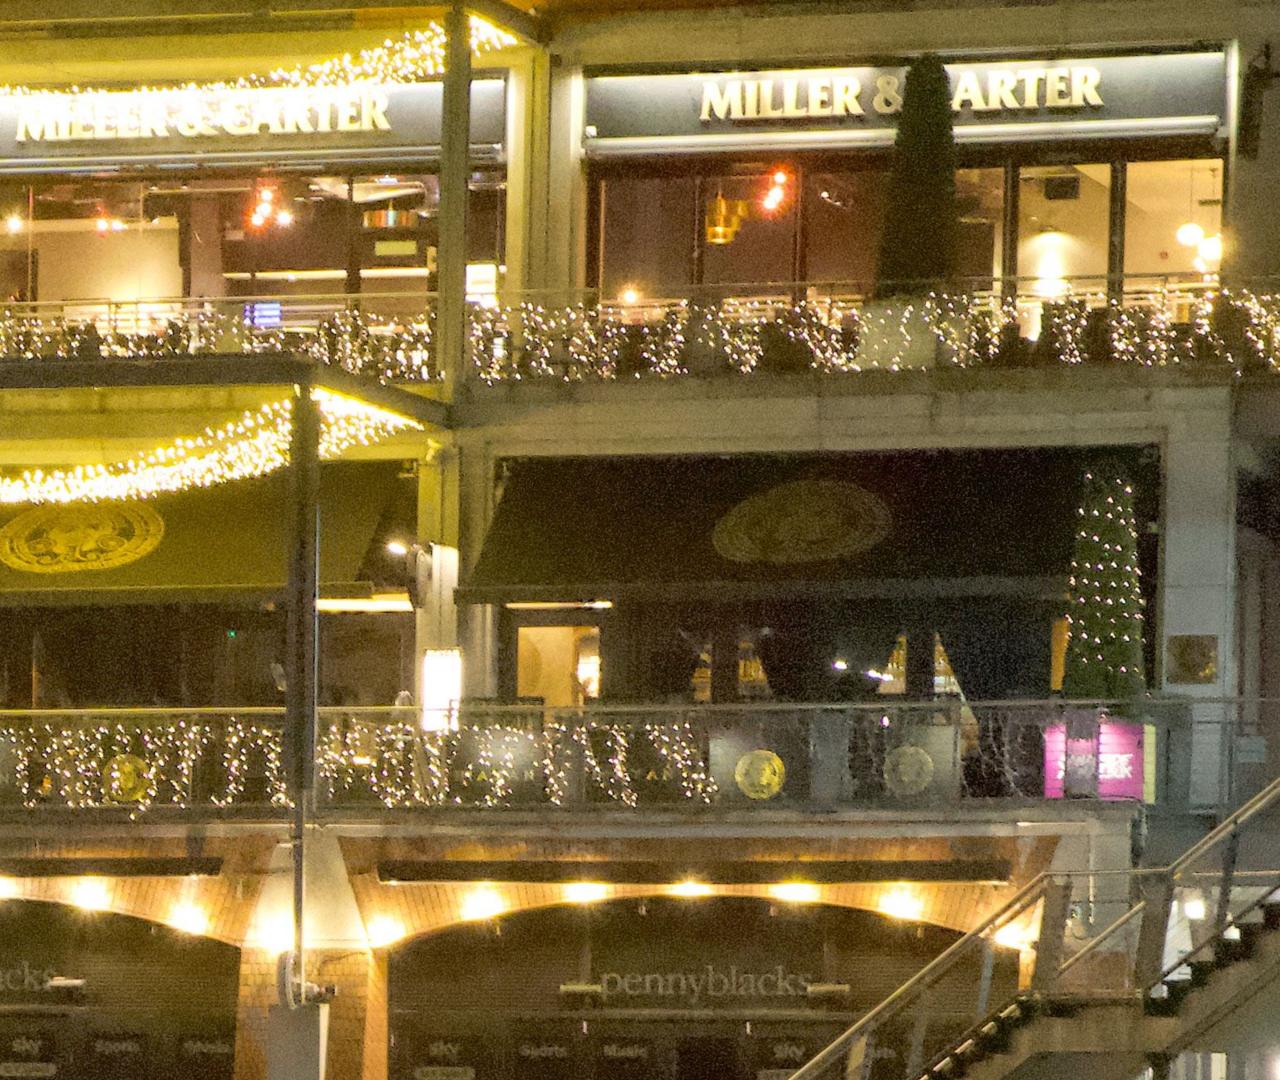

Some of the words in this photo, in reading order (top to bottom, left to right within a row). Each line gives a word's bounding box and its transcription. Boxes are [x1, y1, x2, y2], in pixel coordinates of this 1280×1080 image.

[16, 97, 169, 141] MILLER
[220, 90, 391, 136] CARTER
[700, 76, 865, 122] MILLER
[872, 75, 903, 114] &
[951, 67, 1105, 111] ARTER
[600, 964, 812, 1004] pennyblacks
